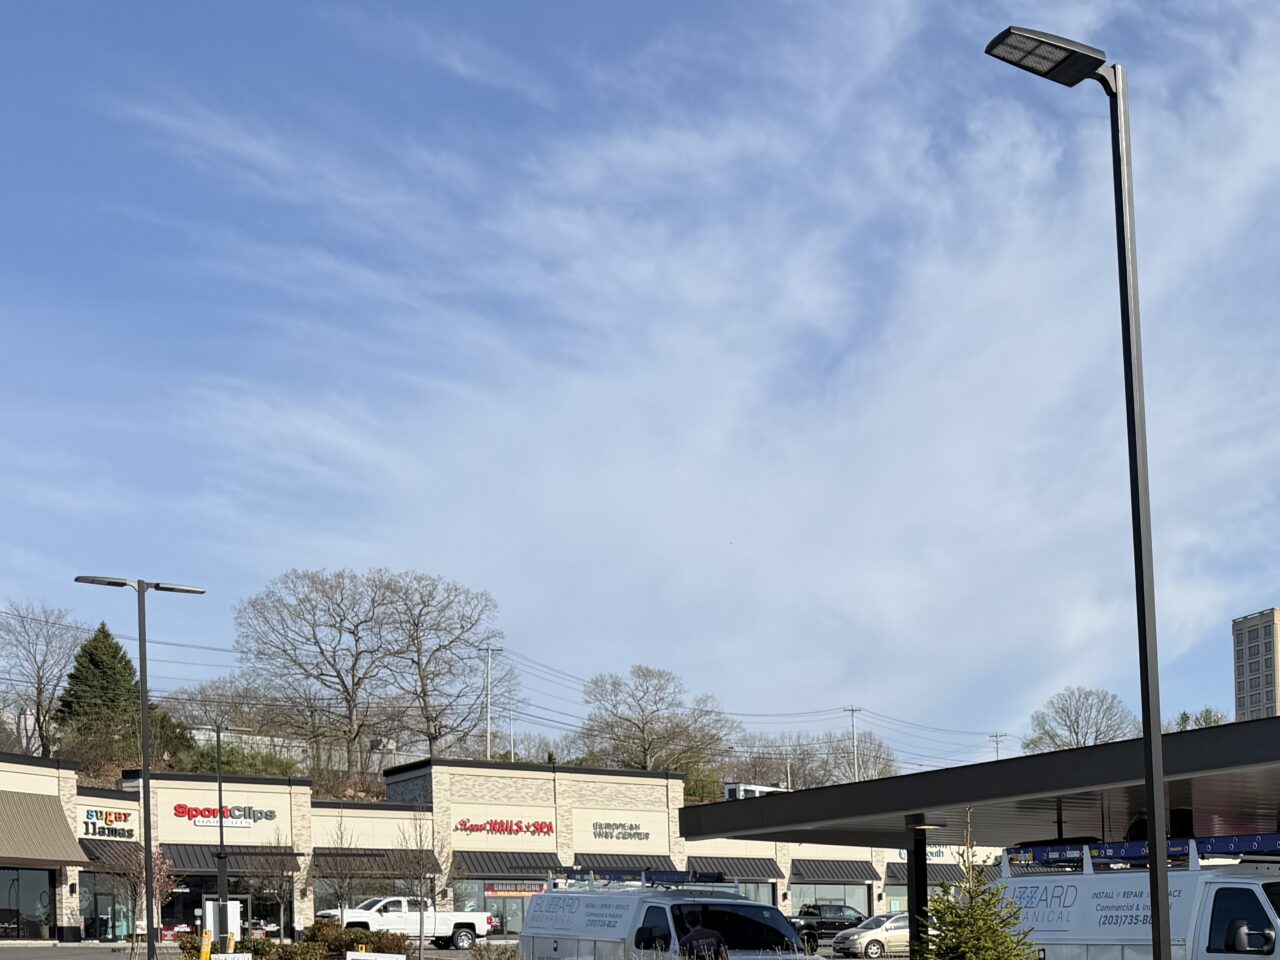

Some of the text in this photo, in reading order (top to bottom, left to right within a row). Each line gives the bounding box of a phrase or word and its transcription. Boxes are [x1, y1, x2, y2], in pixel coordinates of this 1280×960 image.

[86, 809, 131, 826] sugar
[173, 803, 276, 823] SportClips
[83, 821, 134, 839] llamas
[487, 820, 523, 834] NAILS
[531, 821, 554, 836] SPA
[592, 822, 640, 830] EUROPEAN
[616, 832, 650, 841] CENTER
[997, 885, 1078, 908] LIZZARD
[1092, 890, 1143, 899] INSTALL REPAIR
[1095, 903, 1135, 912] Commercial
[1135, 903, 1140, 911] &
[1021, 911, 1072, 923] ANICAL
